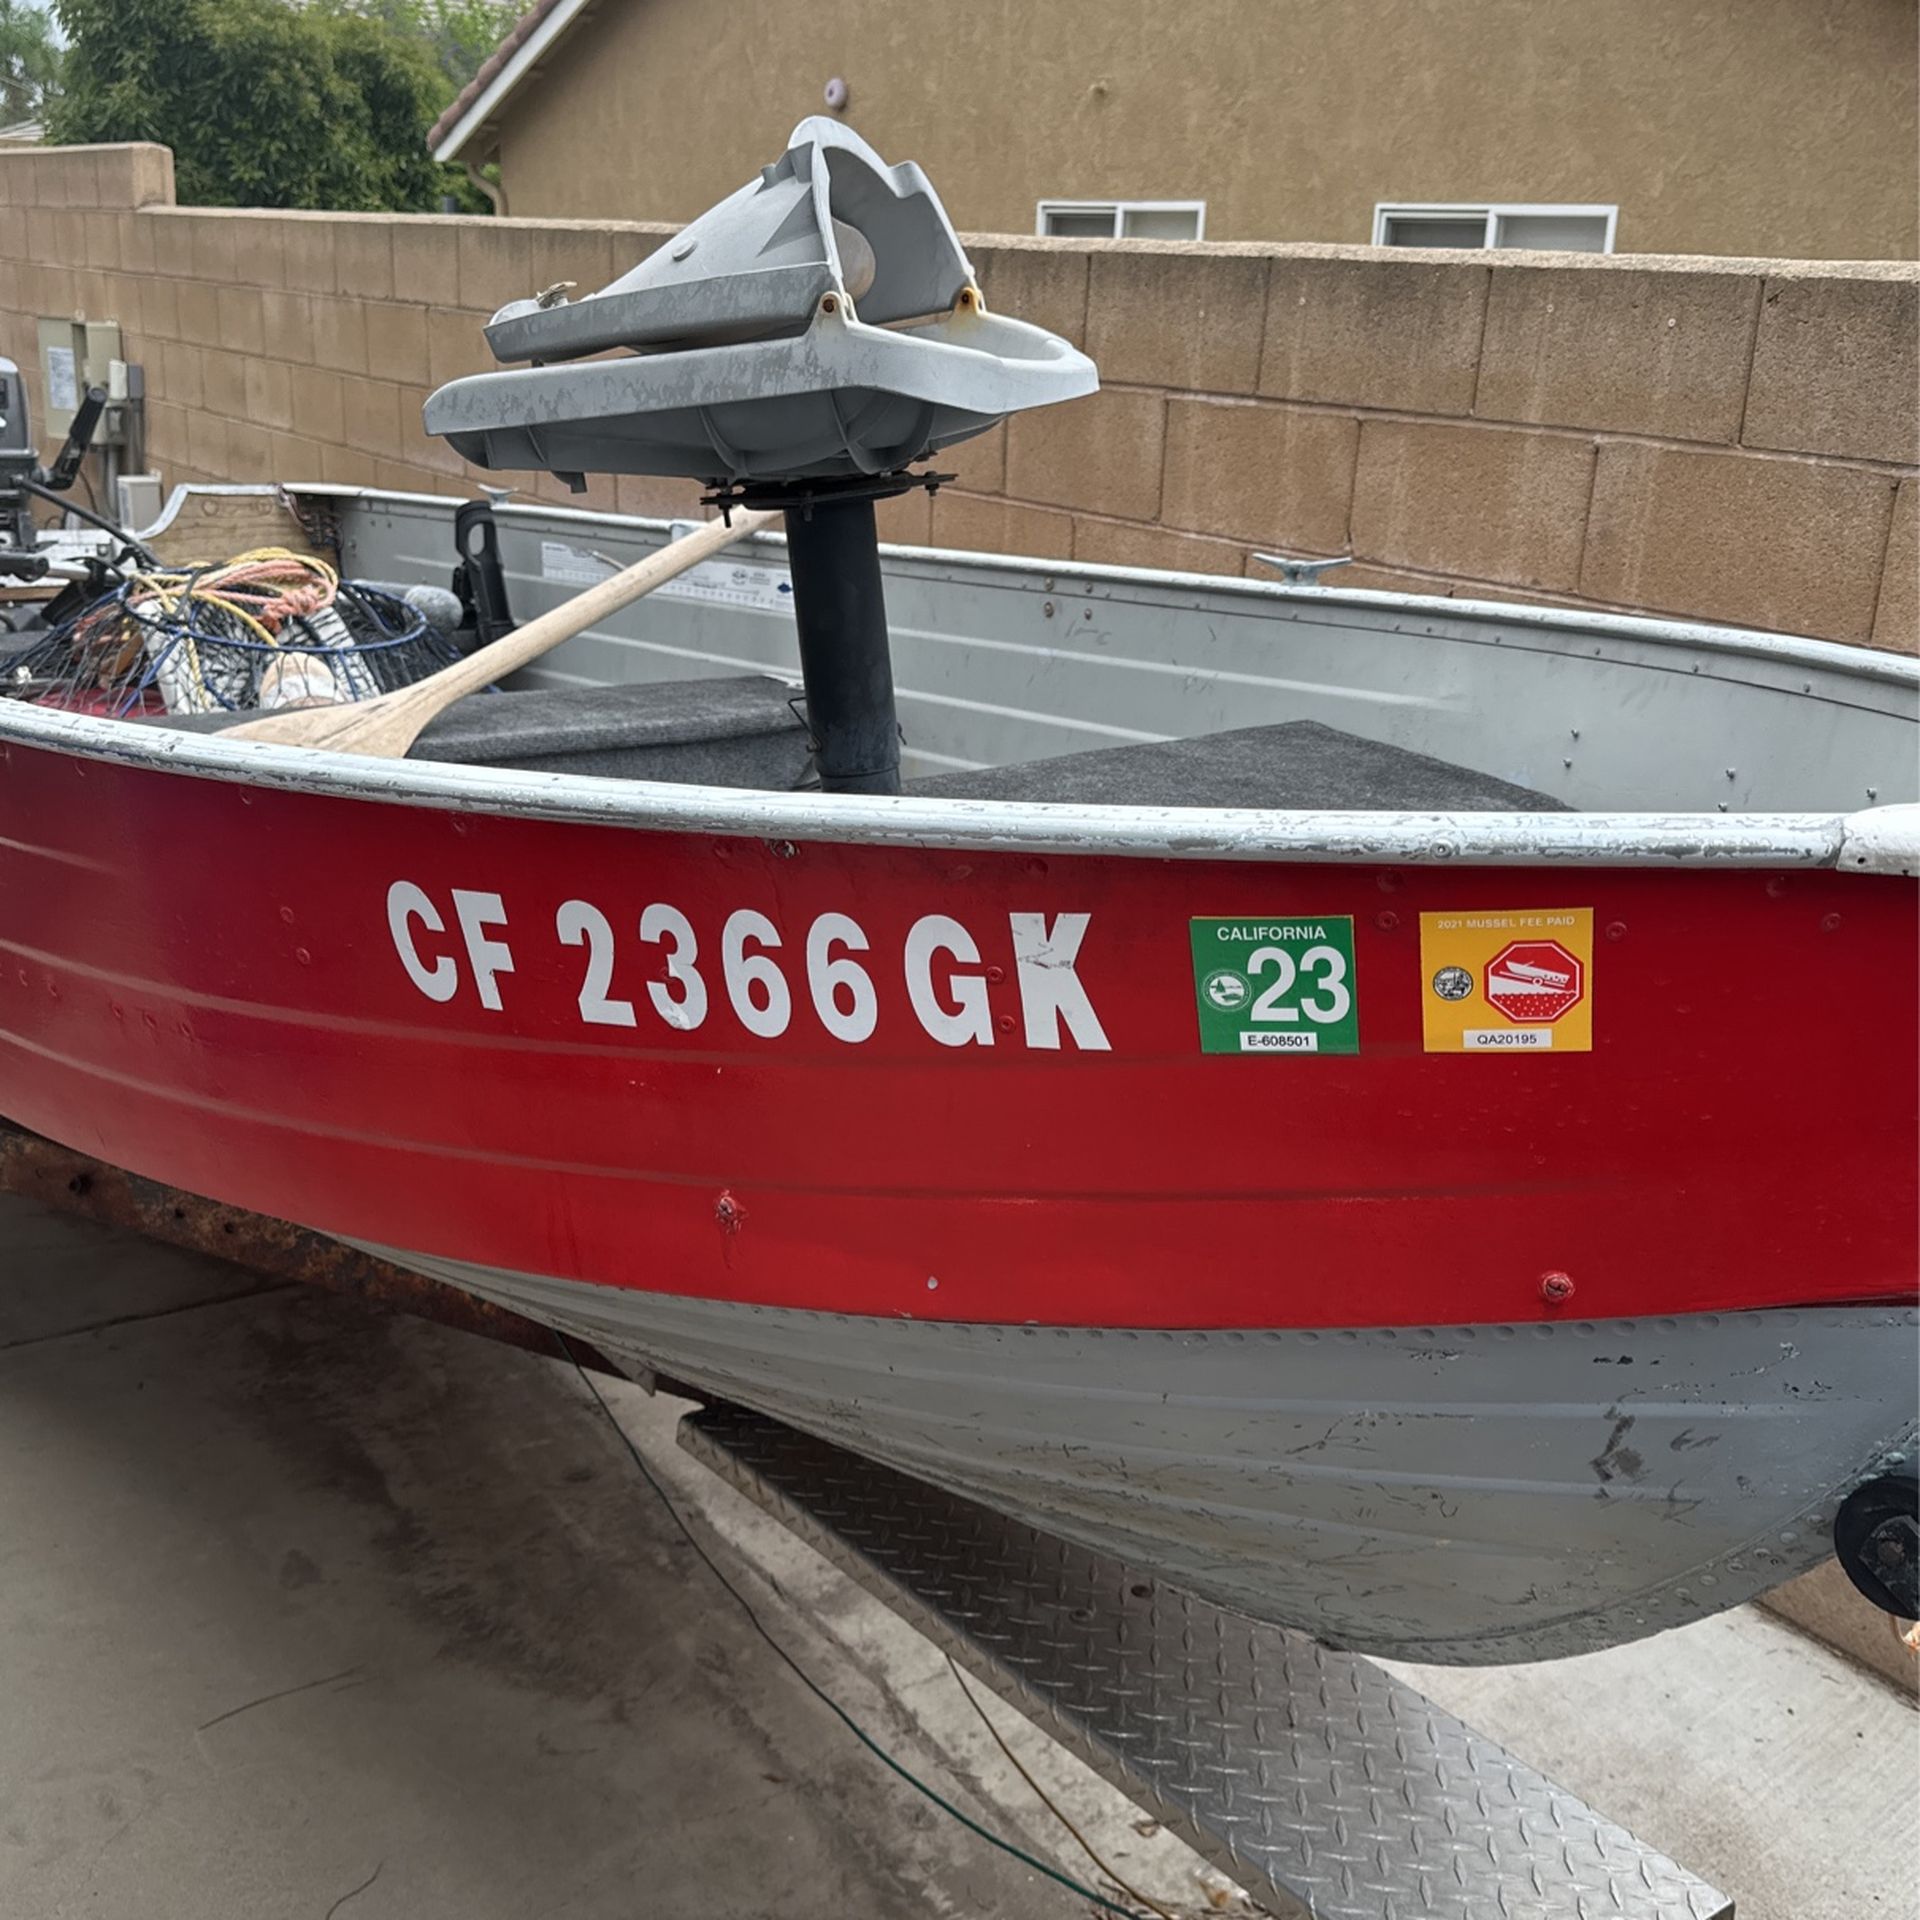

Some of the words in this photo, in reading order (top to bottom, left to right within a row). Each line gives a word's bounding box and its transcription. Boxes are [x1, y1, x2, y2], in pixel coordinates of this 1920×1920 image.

[1437, 919, 1463, 929] 2021
[1466, 917, 1517, 928] MUSSEL
[1519, 916, 1543, 928] FEE
[1546, 915, 1575, 927] PAID
[1217, 925, 1327, 941] CALIFORNIA
[386, 880, 516, 1011] CF
[556, 899, 878, 1044] 2366
[903, 911, 1112, 1052] GK
[1247, 946, 1351, 1024] 23
[1247, 1034, 1311, 1048] E-608501
[1477, 1033, 1537, 1046] QA20195
